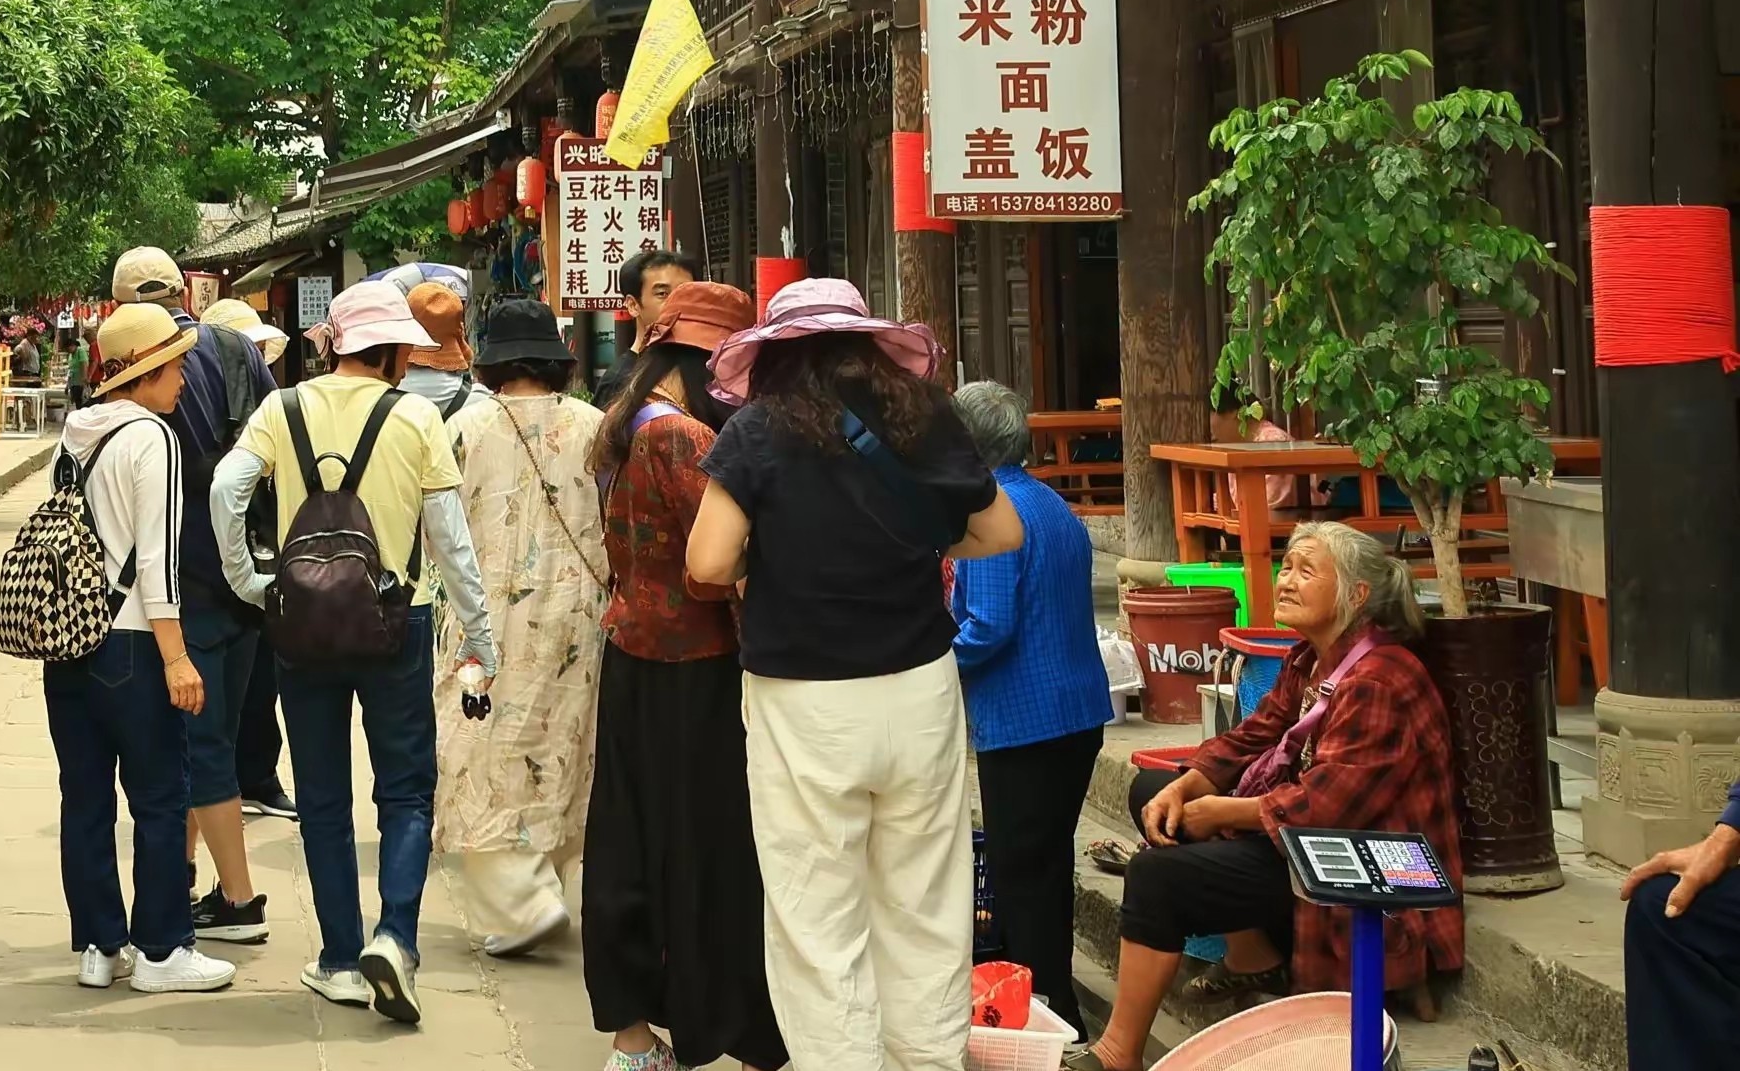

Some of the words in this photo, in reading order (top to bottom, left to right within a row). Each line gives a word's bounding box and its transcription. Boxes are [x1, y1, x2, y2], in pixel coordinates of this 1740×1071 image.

[995, 62, 1051, 113] 面
[564, 144, 660, 166] 兴昭府
[962, 127, 1093, 180] 盖饭
[567, 175, 659, 201] 豆花牛肉
[566, 206, 660, 233] 老火锅
